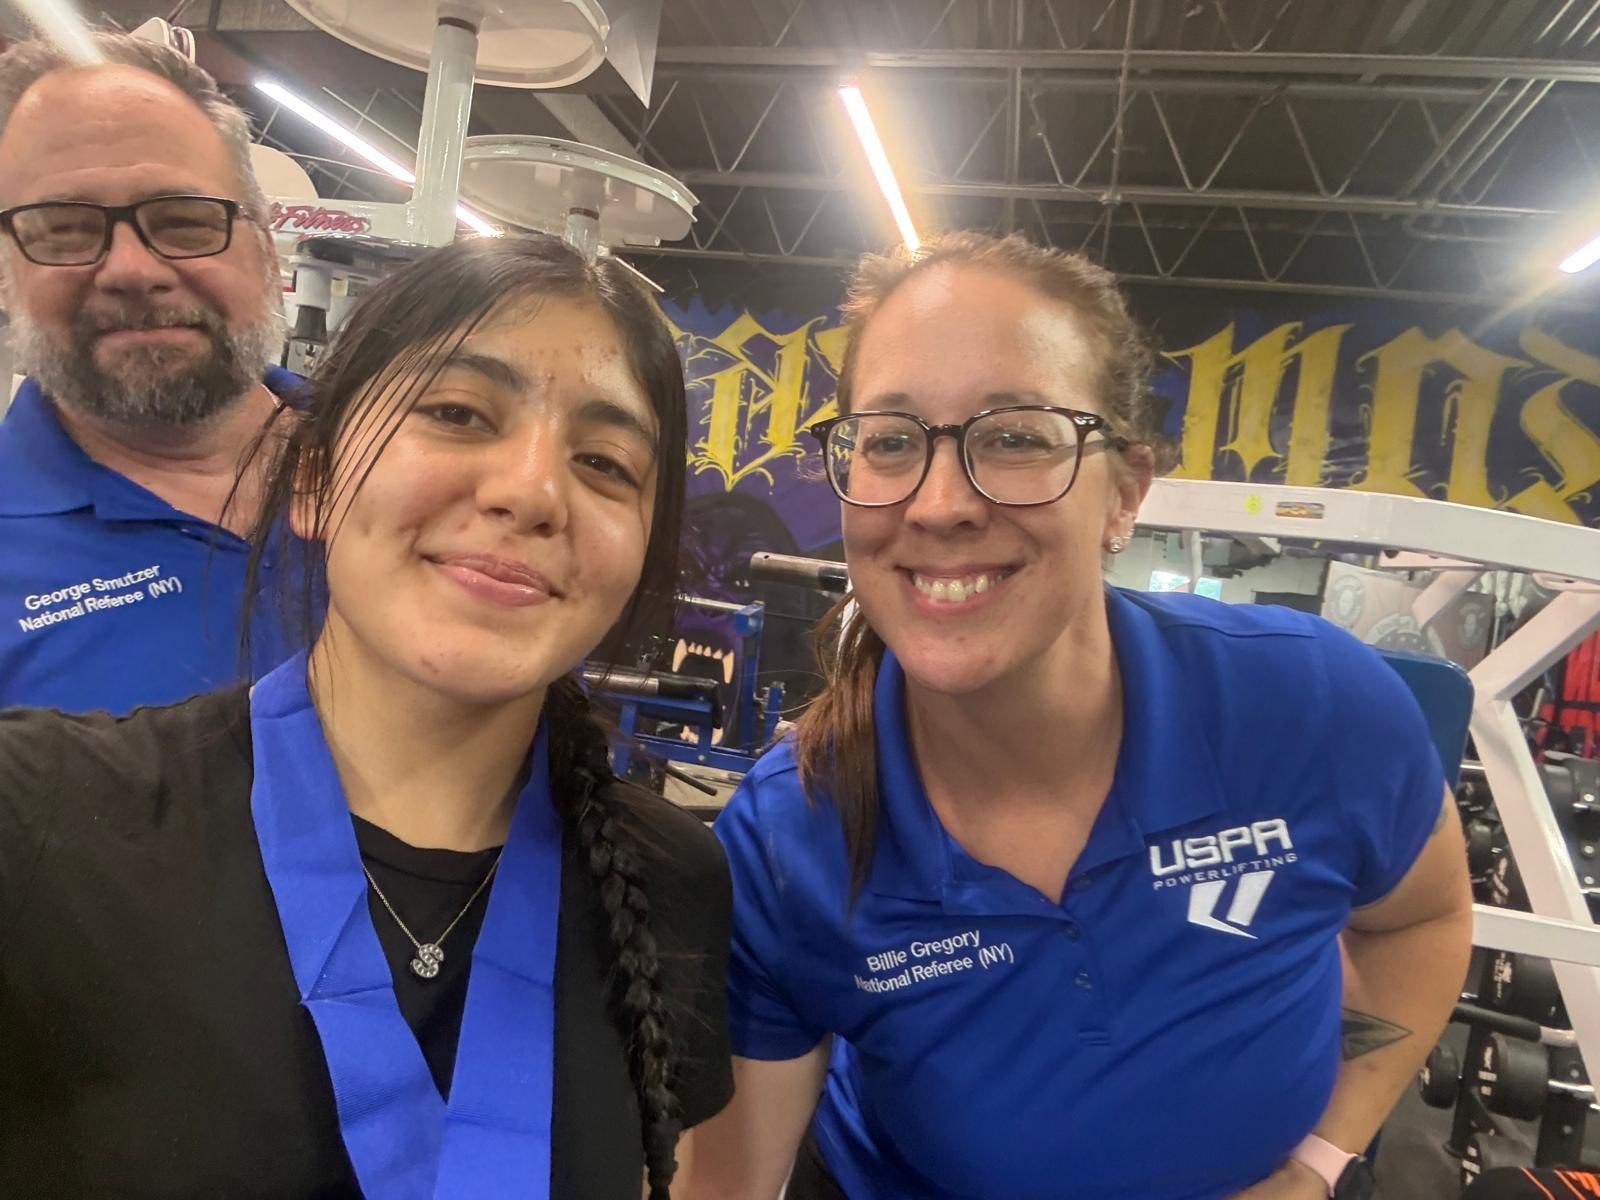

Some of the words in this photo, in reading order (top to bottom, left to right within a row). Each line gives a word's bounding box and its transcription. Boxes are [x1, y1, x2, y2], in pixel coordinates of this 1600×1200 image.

[19, 602, 85, 632] National
[85, 591, 144, 613] Referee
[148, 576, 183, 599] (NY)
[25, 581, 91, 610] George
[92, 564, 161, 592] Smutzer
[1149, 818, 1293, 876] USPA
[1152, 853, 1298, 891] POWERLIFTING
[854, 969, 911, 993] National
[912, 957, 973, 983] Referee
[979, 943, 1014, 969] (NY)
[866, 949, 907, 973] Billie
[910, 930, 980, 959] Gregory
